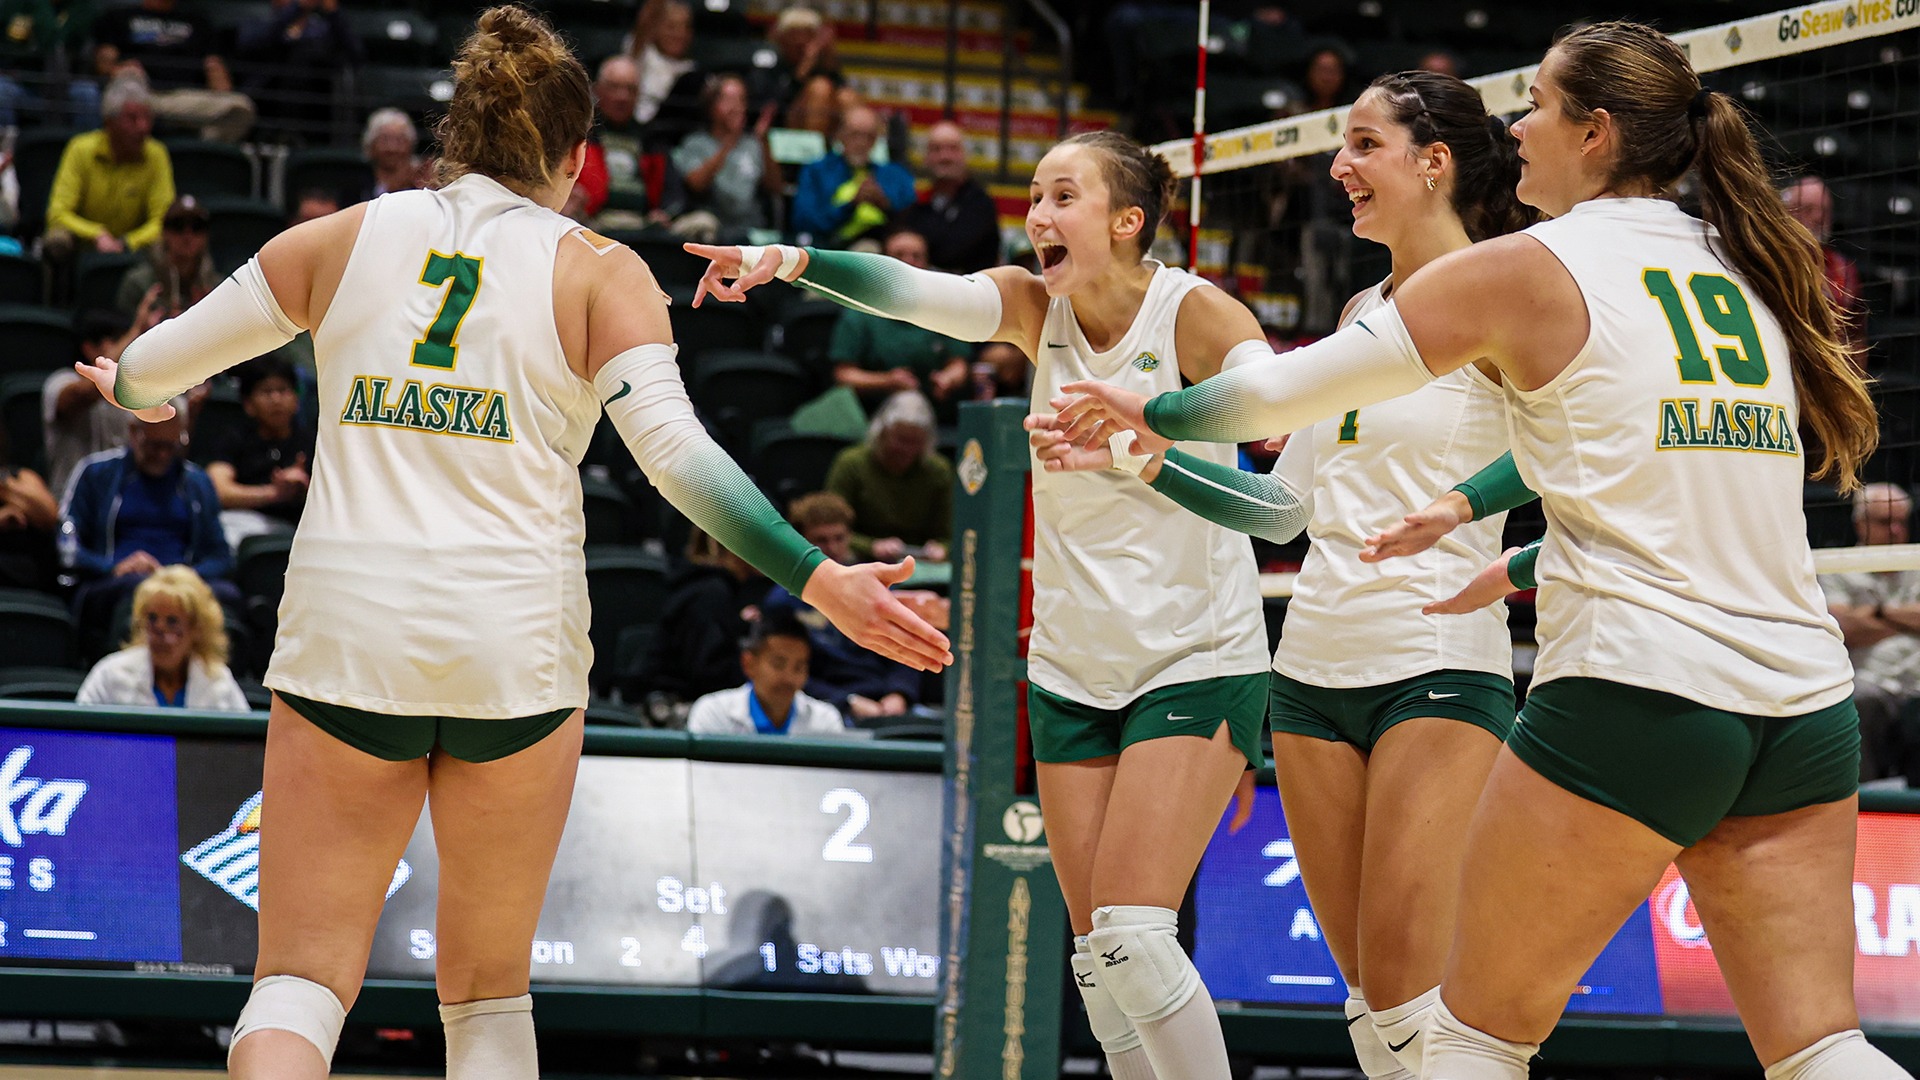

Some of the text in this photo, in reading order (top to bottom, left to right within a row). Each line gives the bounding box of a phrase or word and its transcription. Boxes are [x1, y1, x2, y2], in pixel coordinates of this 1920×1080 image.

[408, 248, 484, 372] 7
[1640, 267, 1772, 389] 19
[339, 374, 515, 445] ALASKA
[1655, 398, 1800, 457] ALASKA
[819, 787, 875, 863] 2
[656, 875, 728, 915] Set
[531, 936, 642, 967] on 2
[681, 924, 709, 958] 4
[759, 941, 777, 972] 1
[796, 943, 873, 976] Sets
